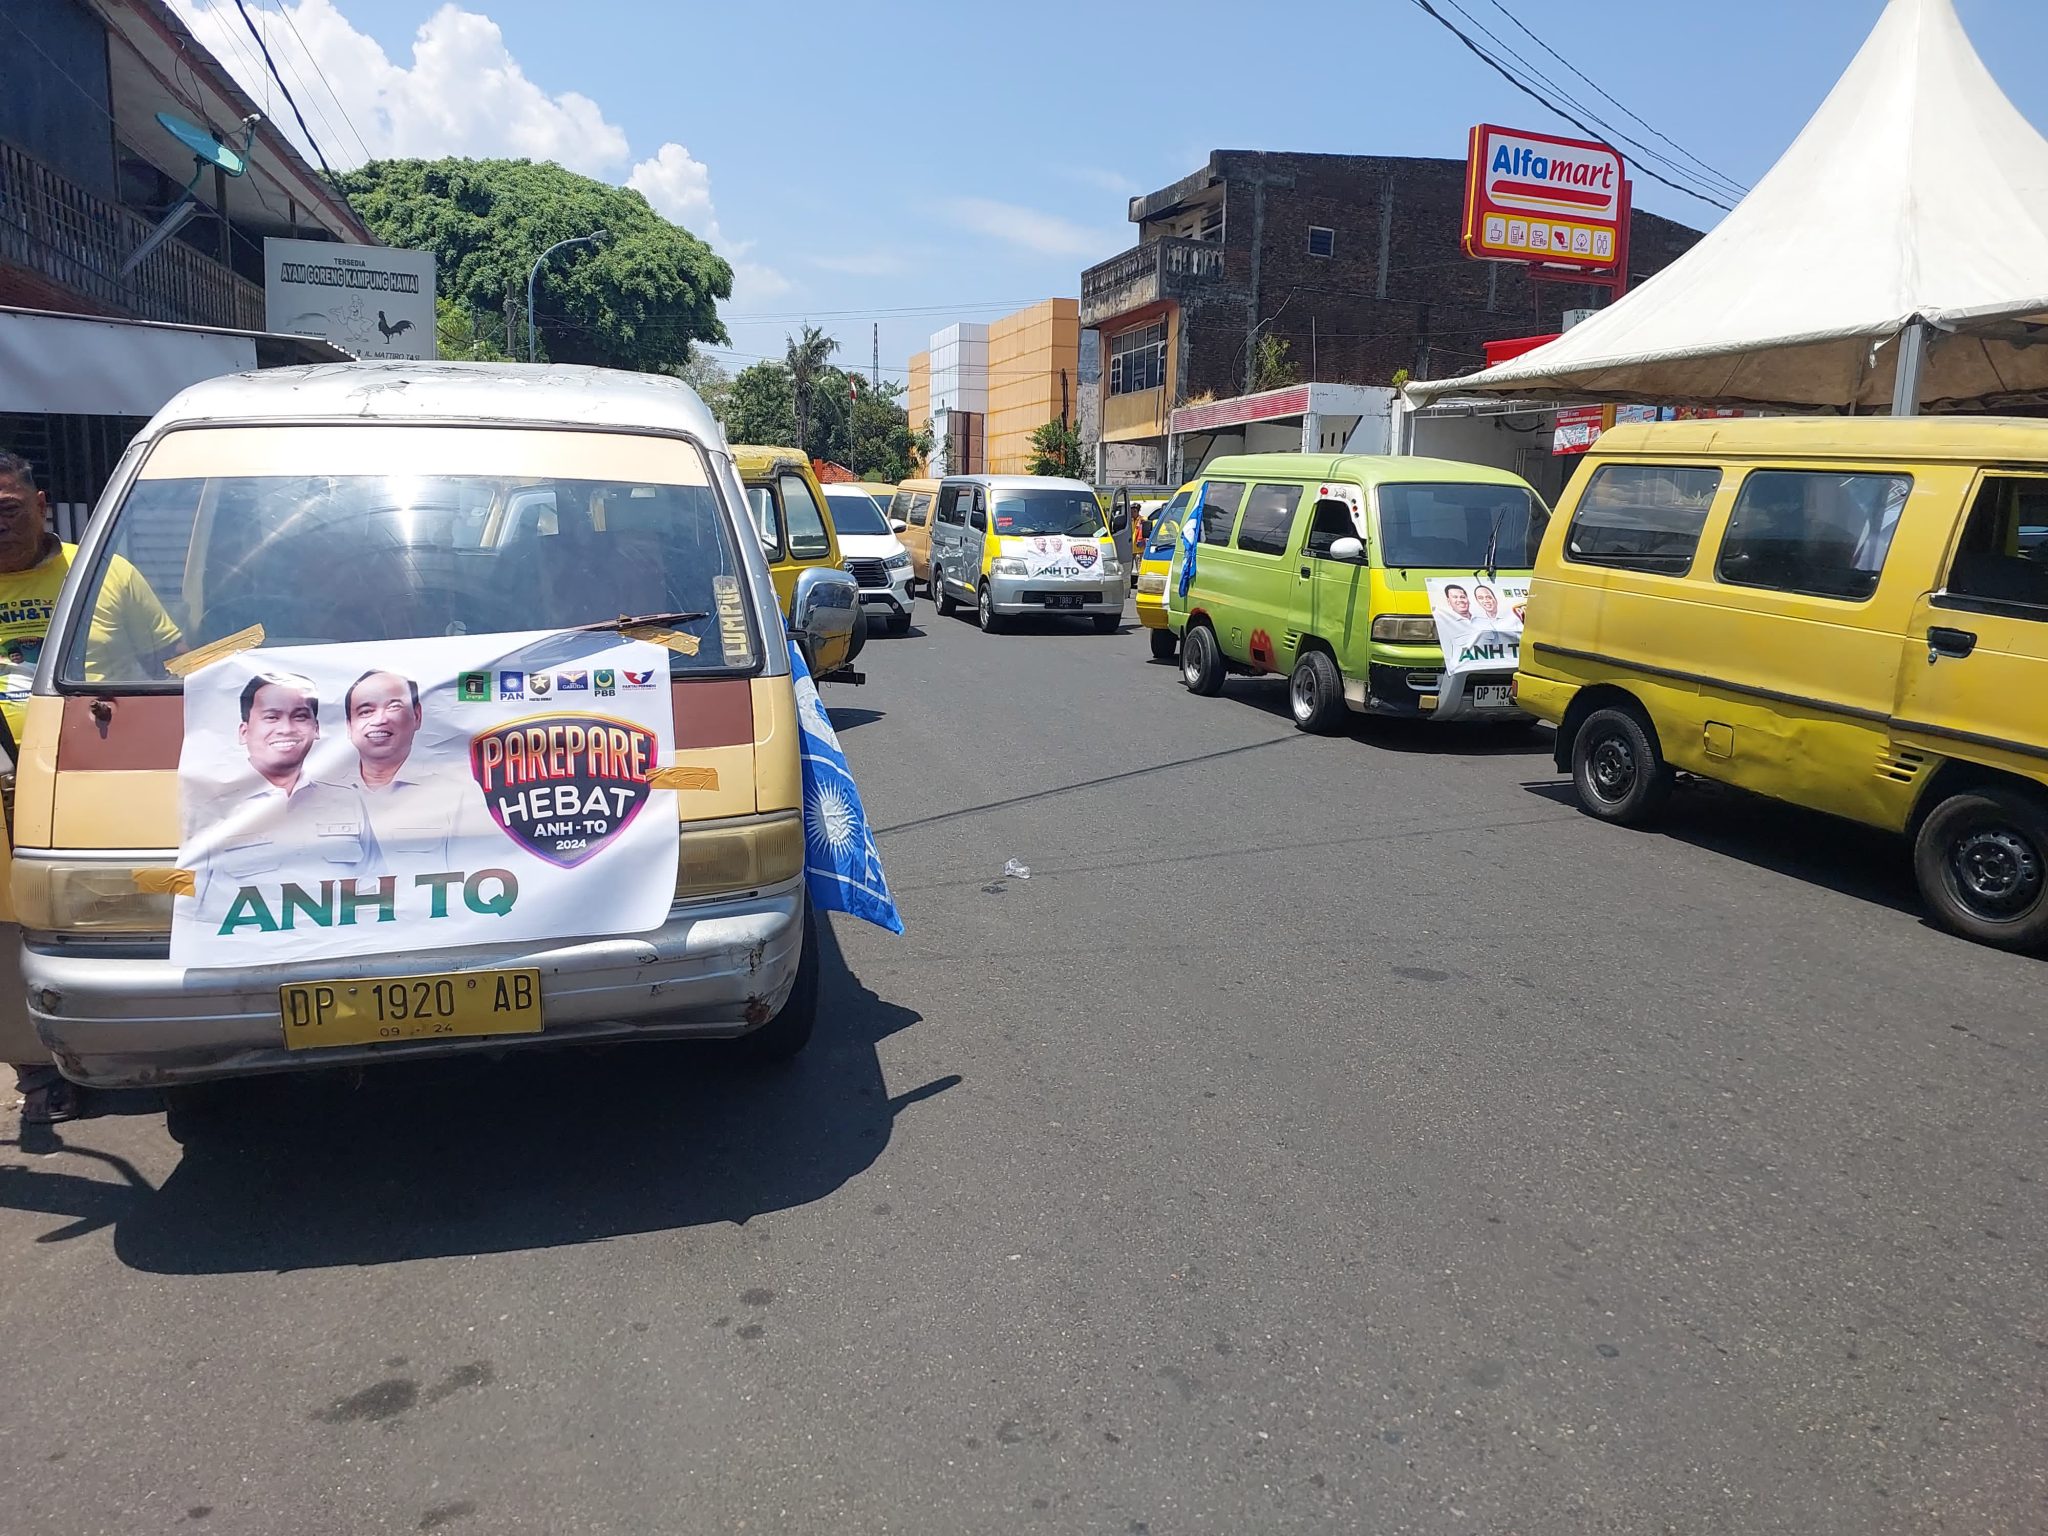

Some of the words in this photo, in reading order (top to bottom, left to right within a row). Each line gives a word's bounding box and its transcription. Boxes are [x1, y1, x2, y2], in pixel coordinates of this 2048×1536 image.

[1492, 144, 1614, 189] Alfamart
[334, 258, 366, 267] TERSEDIA
[281, 263, 307, 284] AYAM
[306, 265, 344, 287] GORENG
[345, 268, 389, 291] KAMPUNG
[389, 272, 419, 294] HAWAI
[375, 351, 404, 360] MATTIRO
[715, 583, 748, 656] LUMPUE
[1459, 644, 1504, 662] ANH
[500, 692, 524, 701] PAN
[594, 689, 616, 697] PBB
[1477, 687, 1489, 700] DP
[482, 725, 647, 792] PAREPARE
[498, 785, 636, 827] HEBAT
[555, 839, 587, 850] 2024
[216, 875, 398, 936] ANH
[414, 868, 519, 918] TQ
[289, 987, 335, 1027] DP
[372, 979, 455, 1021] 1920
[493, 975, 533, 1012] AB
[379, 1027, 400, 1037] 09
[434, 1023, 453, 1033] 24
